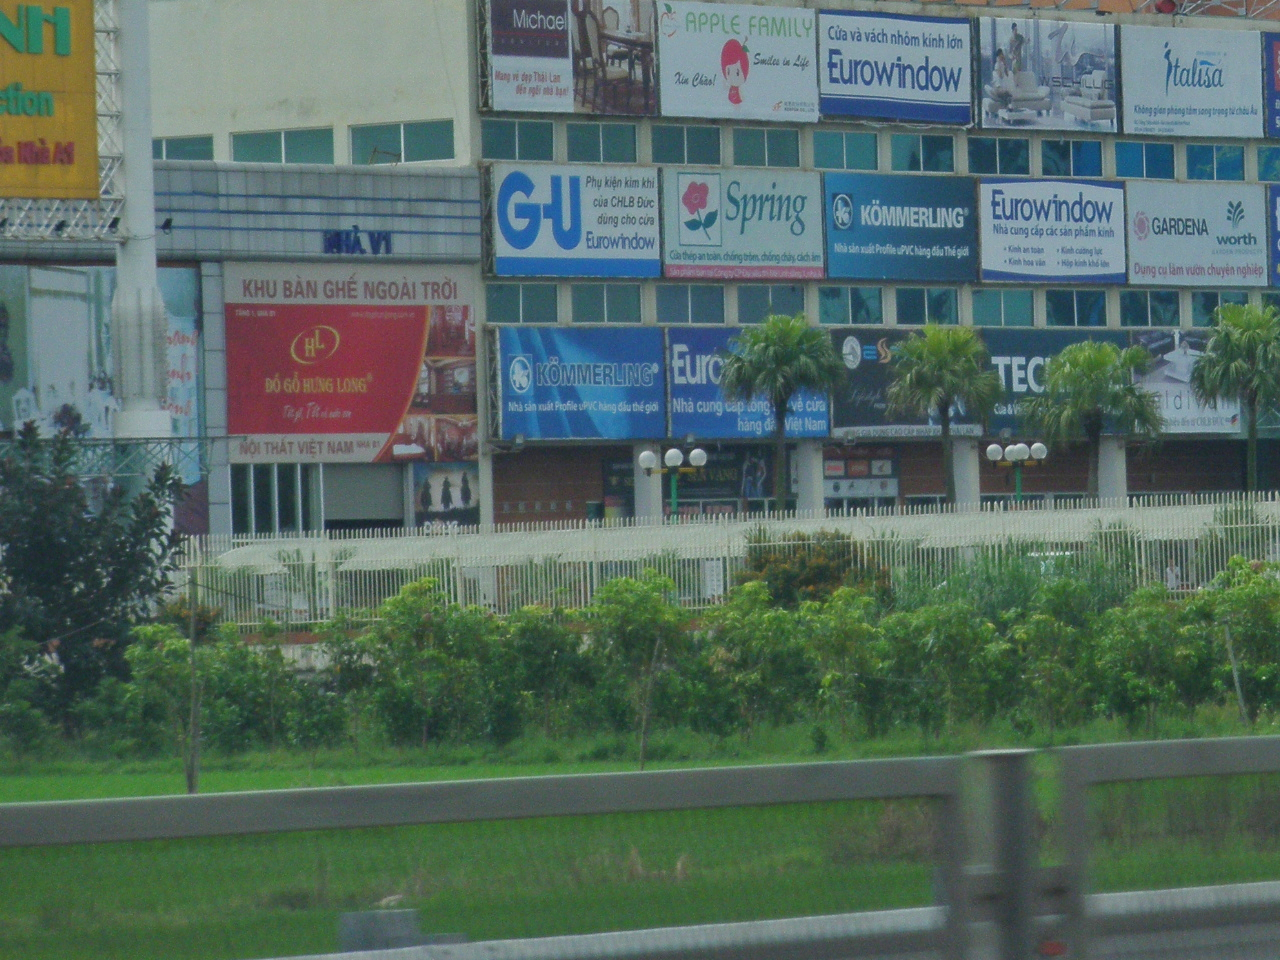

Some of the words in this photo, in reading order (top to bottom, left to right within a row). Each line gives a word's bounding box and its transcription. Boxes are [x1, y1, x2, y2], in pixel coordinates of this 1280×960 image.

[513, 9, 568, 30] Michael
[685, 11, 741, 34] APPLE
[748, 15, 813, 38] FAMILY
[828, 25, 848, 41] Cửa
[849, 27, 861, 42] và
[864, 28, 888, 44] vách
[890, 29, 920, 47] nhôm
[922, 32, 944, 49] kính
[947, 34, 963, 49] lớn
[753, 52, 780, 66] Smiles
[783, 56, 791, 66] in
[793, 54, 810, 71] Life
[827, 48, 963, 92] Eurowindow
[674, 71, 689, 85] Xin
[604, 176, 622, 190] kiện
[625, 177, 640, 189] kim
[611, 196, 635, 208] CHLB
[637, 196, 655, 209] Đức
[725, 181, 808, 236] Spring
[990, 188, 1114, 223] Eurowindow
[621, 214, 637, 226] cho
[860, 200, 964, 228] KÖMMERLING
[1010, 227, 1029, 238] cung
[1074, 224, 1096, 239] phẩm
[1151, 217, 1209, 236] GARDENA
[586, 231, 655, 250] Eurowindow
[1216, 233, 1257, 245] worth
[875, 243, 896, 255] Profile
[1207, 262, 1235, 279] chuyên
[242, 278, 277, 299] KHU
[283, 275, 318, 299] BÀN
[323, 273, 358, 299] GHẾ
[363, 276, 416, 300] NGOÀI
[420, 276, 458, 300] TRỜI
[536, 356, 654, 387] KÖMMERLING
[508, 401, 523, 412] Nhà
[555, 400, 577, 412] Profile
[599, 401, 617, 414] hàng
[672, 397, 694, 413] Nhà
[697, 399, 723, 416] cung
[737, 418, 762, 435] hàng
[805, 418, 827, 431] Nam
[298, 438, 322, 458] VIỆT
[327, 441, 355, 455] NAM
